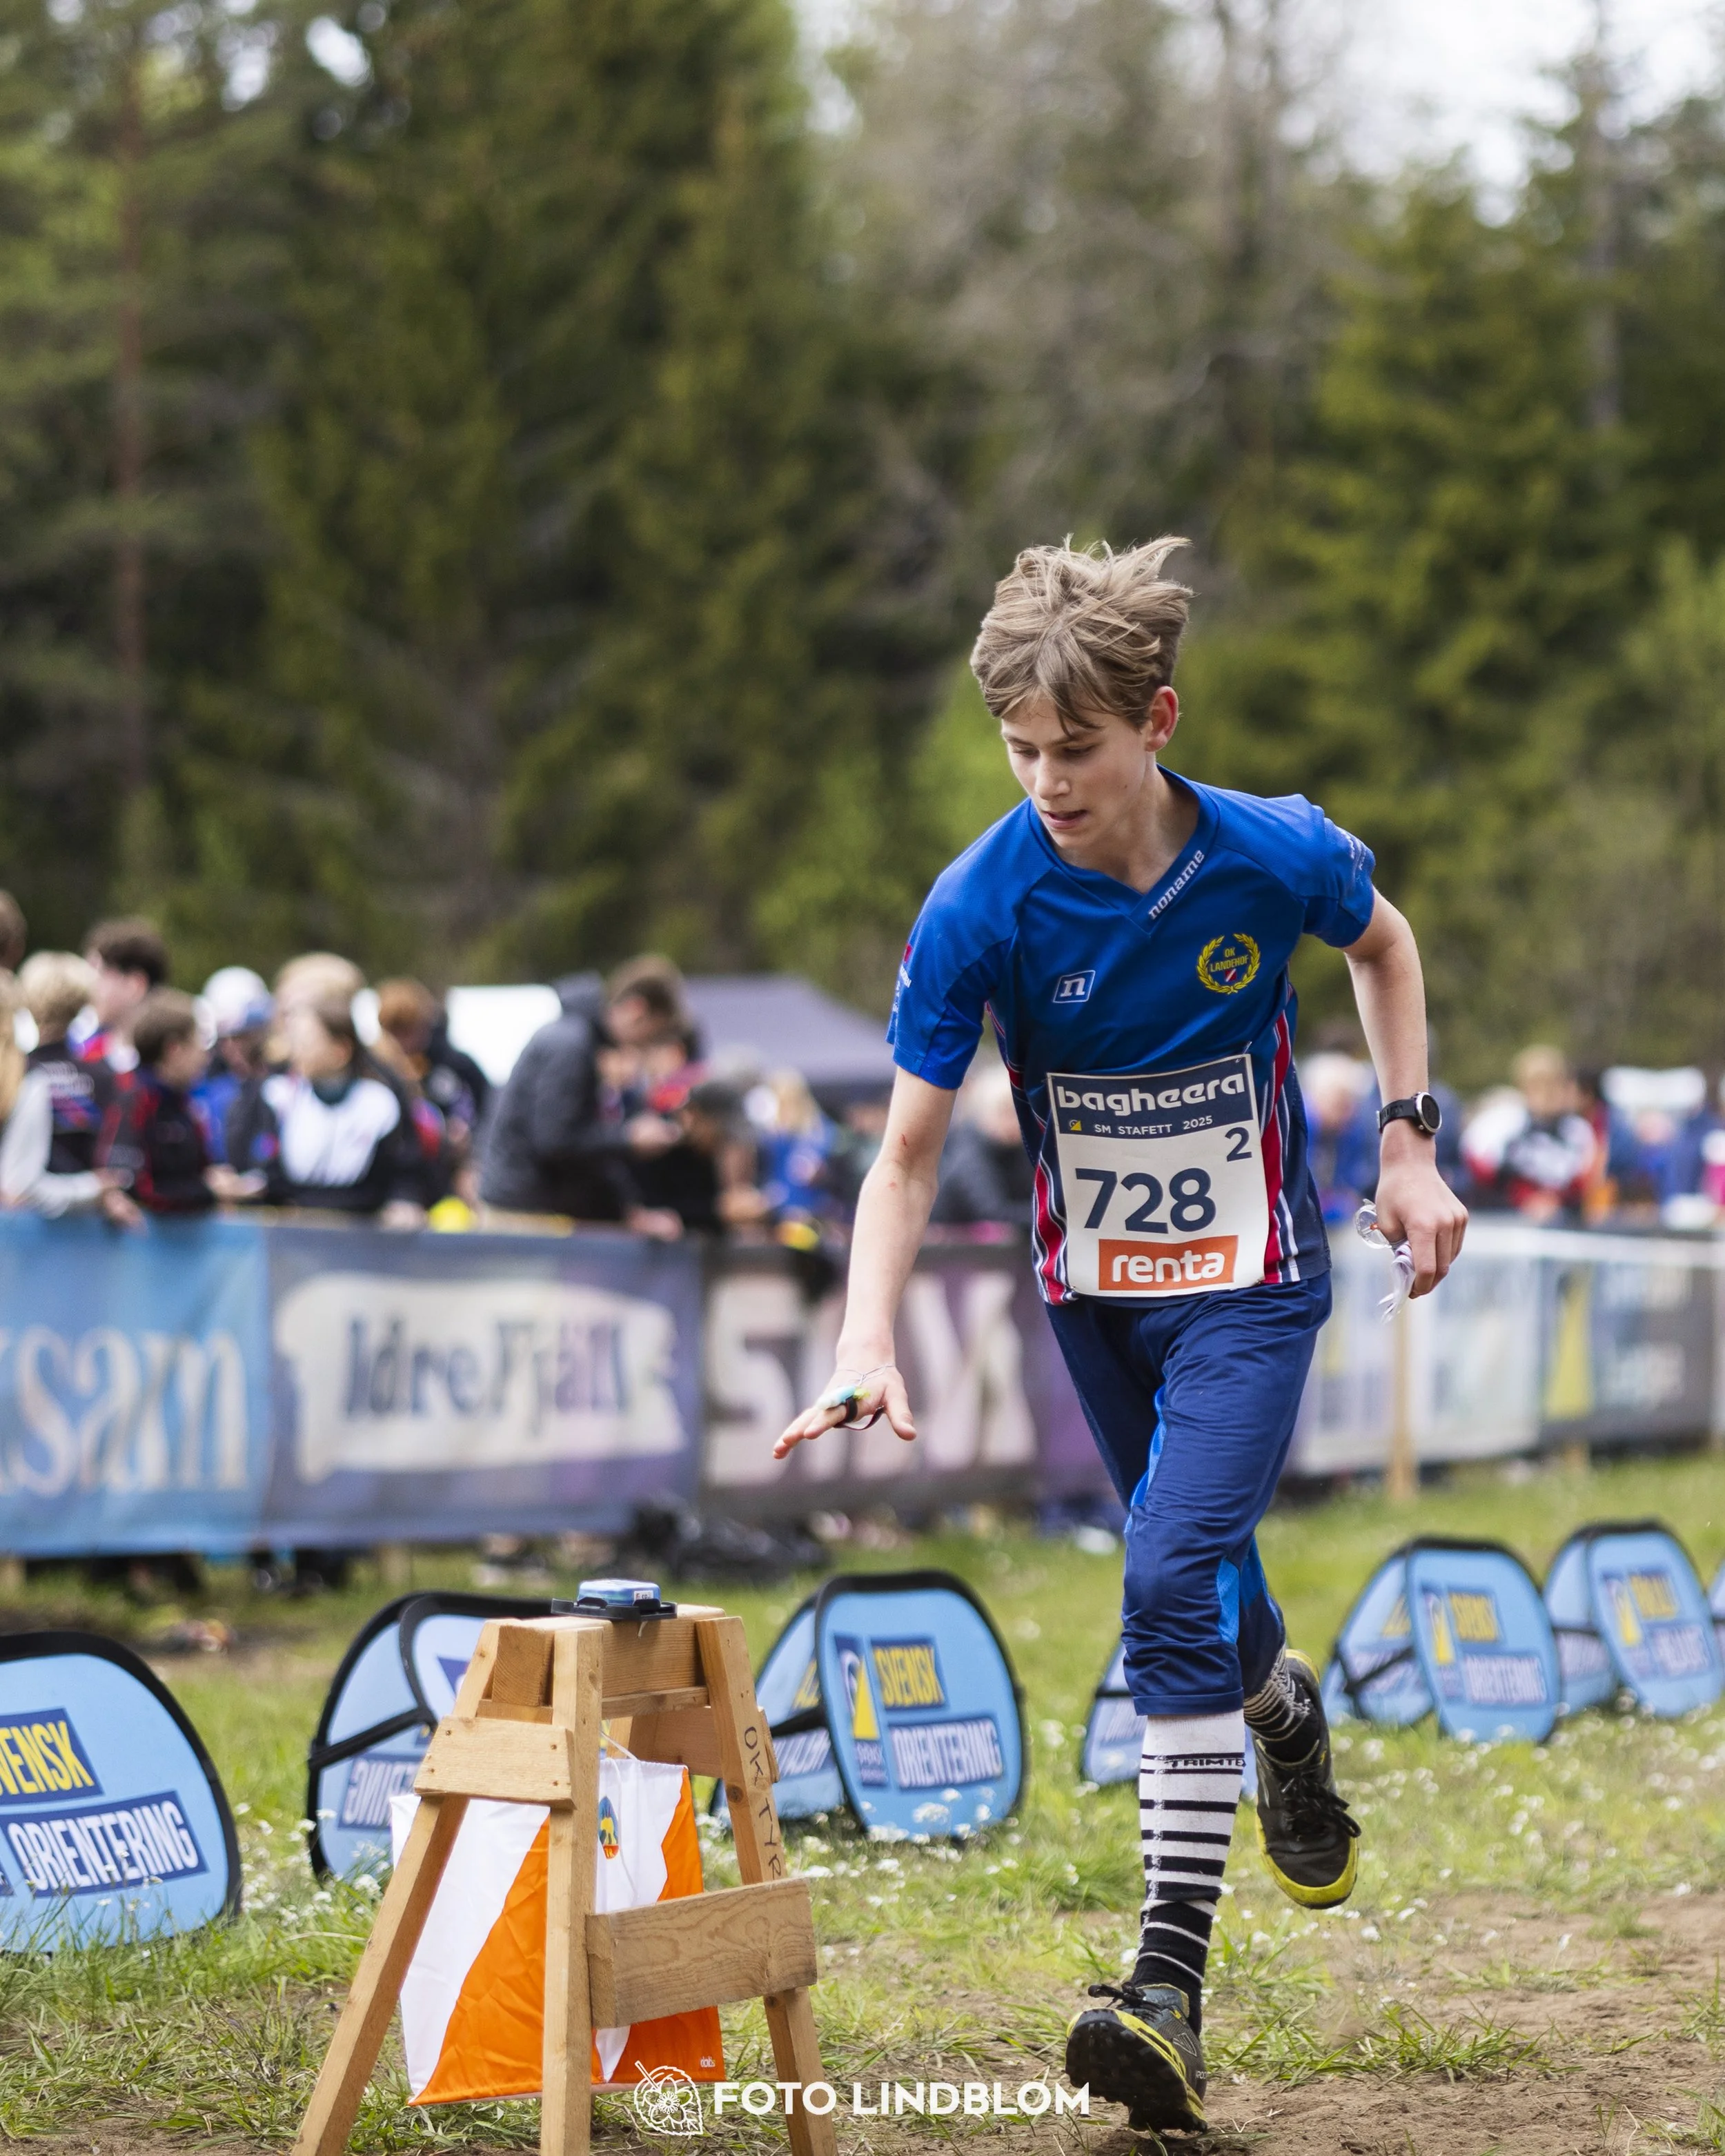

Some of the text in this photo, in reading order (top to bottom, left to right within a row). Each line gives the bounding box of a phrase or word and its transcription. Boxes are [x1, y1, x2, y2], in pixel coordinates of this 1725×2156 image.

[1148, 850, 1205, 920] noname
[1210, 955, 1250, 972] LANDEHOF
[1224, 947, 1236, 958] OK
[1057, 1074, 1245, 1116] bagheera
[1094, 1116, 1214, 1136] SM STAFETT 2025
[1225, 1127, 1252, 1162] 2
[1075, 1167, 1217, 1234] 728
[1112, 1250, 1225, 1283] renta
[873, 1645, 945, 1708] SVENSK
[745, 1727, 765, 1786] OK
[891, 1717, 1003, 1788] ORIENTERING
[8, 1800, 199, 1891] ORIENTERING
